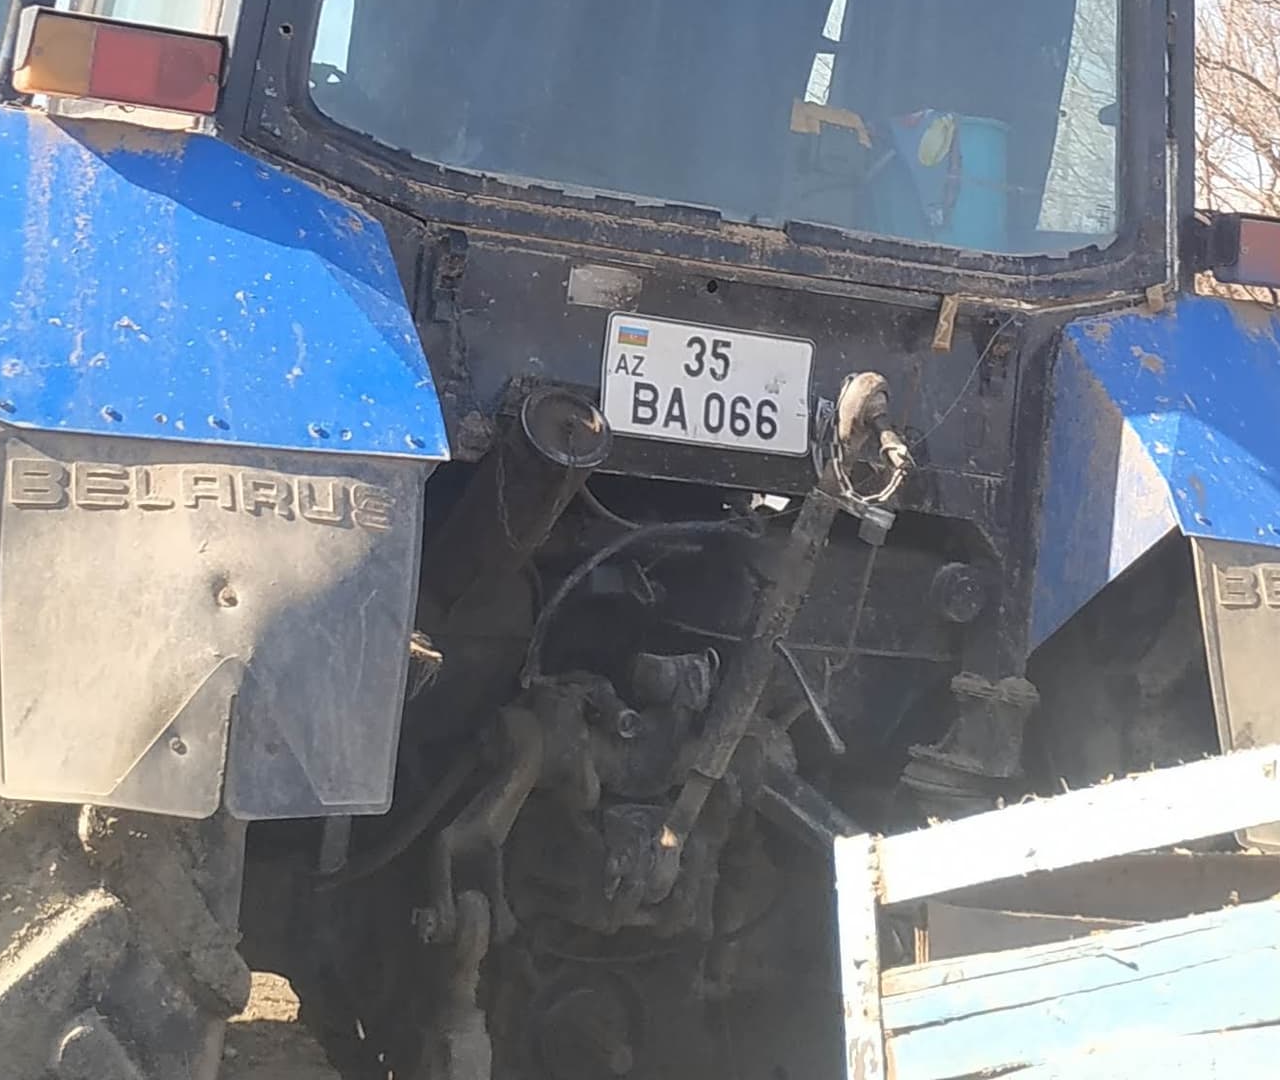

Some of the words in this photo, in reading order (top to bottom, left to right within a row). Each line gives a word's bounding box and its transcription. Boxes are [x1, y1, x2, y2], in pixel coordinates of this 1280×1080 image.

[614, 353, 645, 377] AZ
[684, 336, 732, 381] 35
[631, 382, 688, 431] BA
[704, 392, 778, 440] 066
[9, 458, 397, 532] BELARUS
